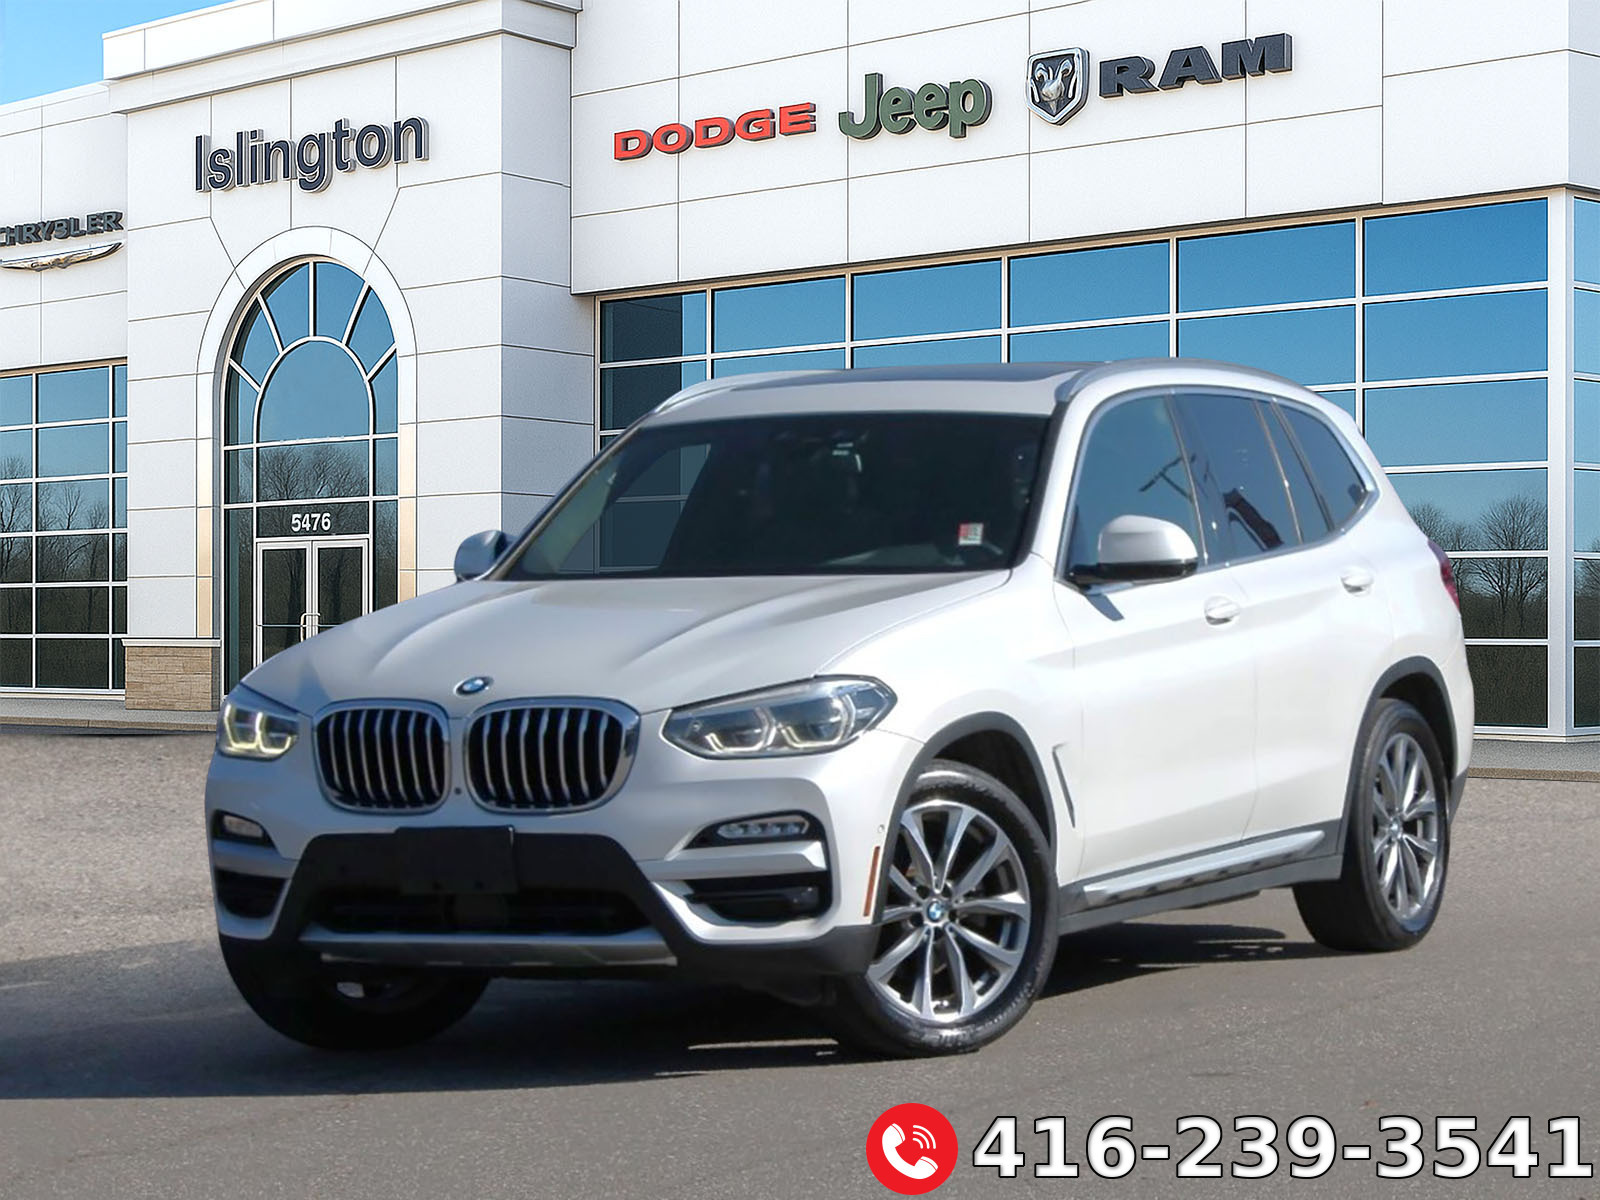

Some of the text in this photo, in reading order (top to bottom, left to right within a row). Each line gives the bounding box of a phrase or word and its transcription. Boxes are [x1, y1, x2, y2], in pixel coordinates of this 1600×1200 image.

[614, 33, 1293, 161] DODGE Jeep RAM
[195, 116, 430, 192] Islington
[291, 512, 331, 532] 5476
